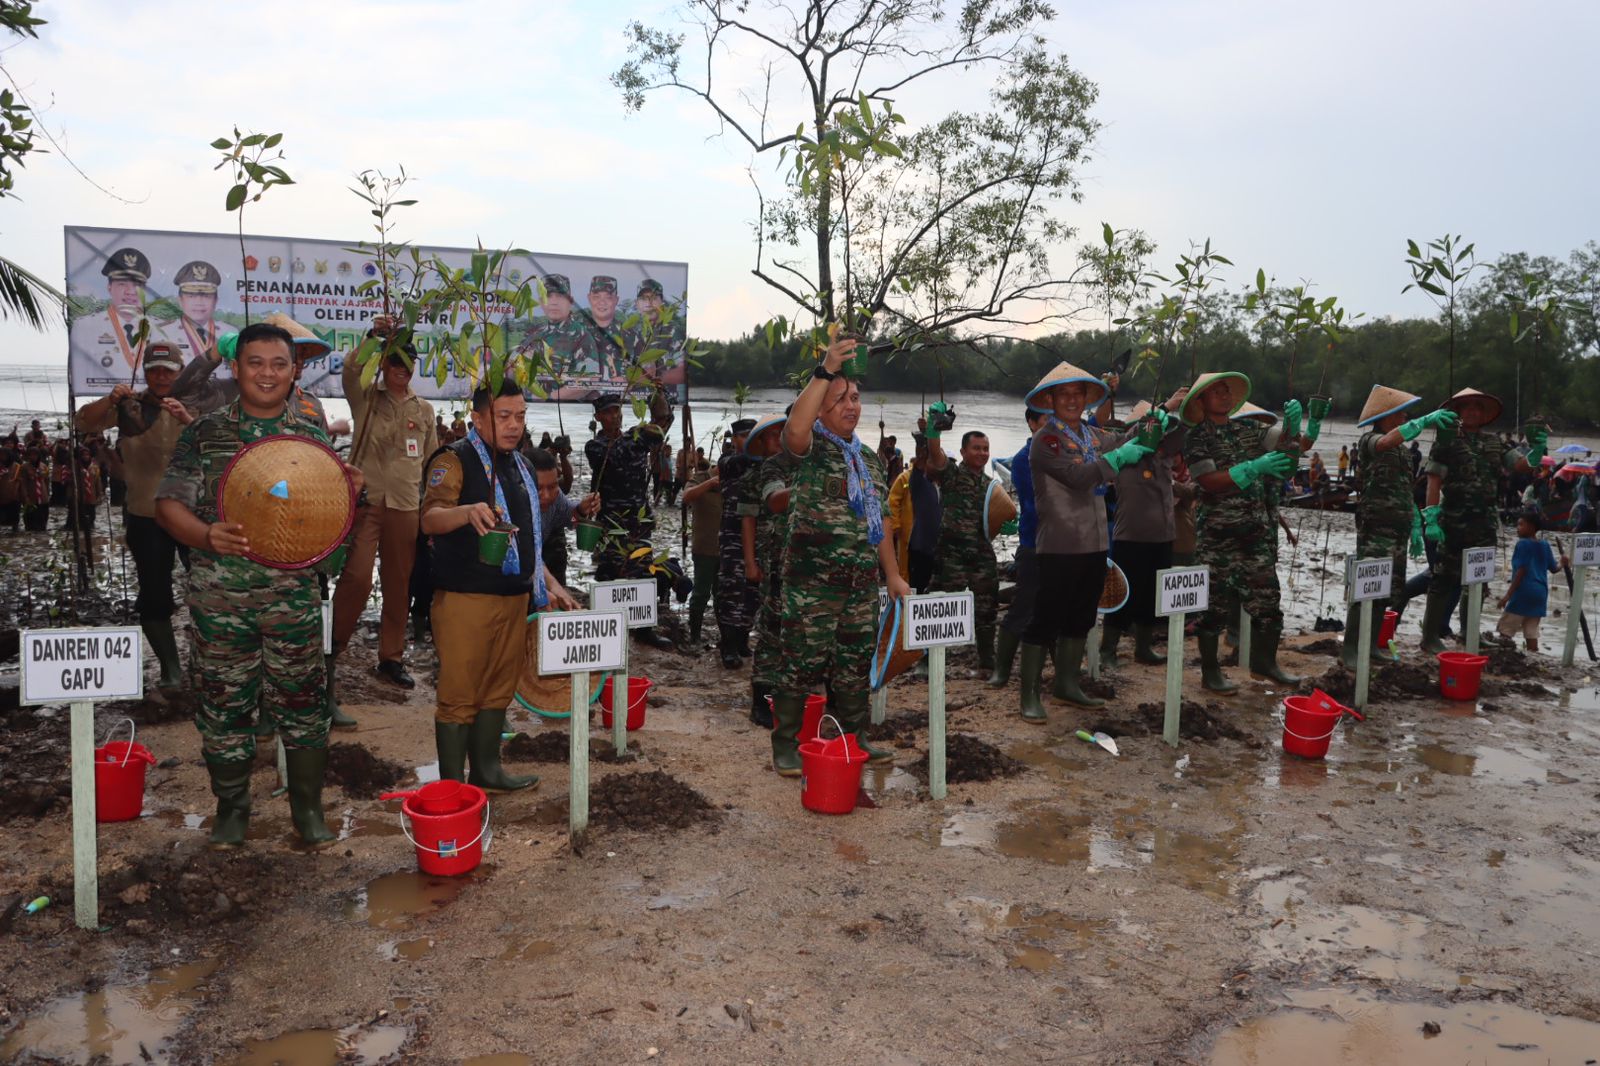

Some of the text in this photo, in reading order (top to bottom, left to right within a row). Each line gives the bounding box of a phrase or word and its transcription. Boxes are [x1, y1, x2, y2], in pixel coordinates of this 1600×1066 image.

[236, 279, 345, 297] PENANAMAN
[239, 294, 283, 305] SECARA
[285, 296, 339, 307] SERENTAK
[314, 307, 355, 322] OLEH
[1357, 564, 1380, 579] DANREM
[1164, 572, 1205, 591] KAPOLDA
[1363, 580, 1382, 595] GATAM
[611, 586, 638, 603] BUPATI
[1170, 591, 1198, 609] JAMBI
[628, 604, 652, 621] TIMUR
[912, 599, 967, 620] PANGDAM II
[547, 618, 618, 641] GUBERNUR
[915, 621, 965, 641] SRIWIJAYA
[33, 636, 132, 662] DANREM 042
[562, 643, 602, 664] JAMBI
[61, 666, 105, 691] GAPU
